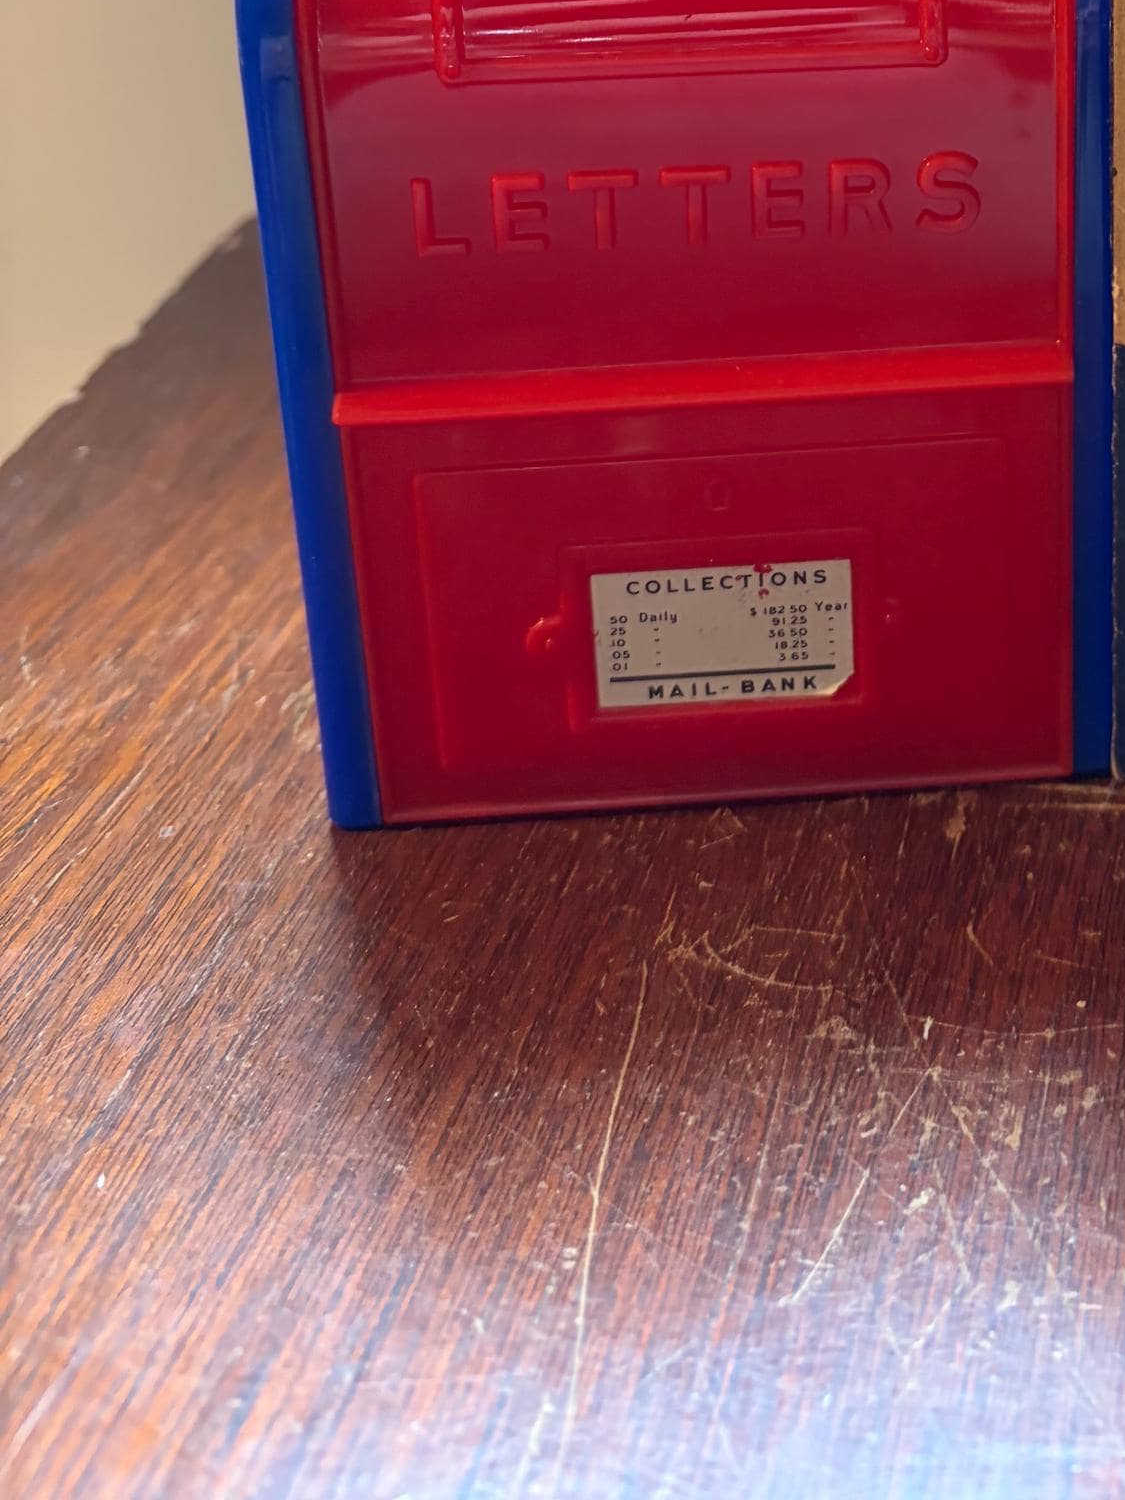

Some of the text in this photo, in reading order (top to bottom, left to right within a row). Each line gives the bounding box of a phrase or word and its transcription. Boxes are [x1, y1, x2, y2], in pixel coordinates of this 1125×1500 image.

[411, 151, 983, 259] LETTERS
[626, 569, 828, 596] COLLECTIONS
[639, 609, 678, 624] Daily
[814, 601, 848, 612] Year
